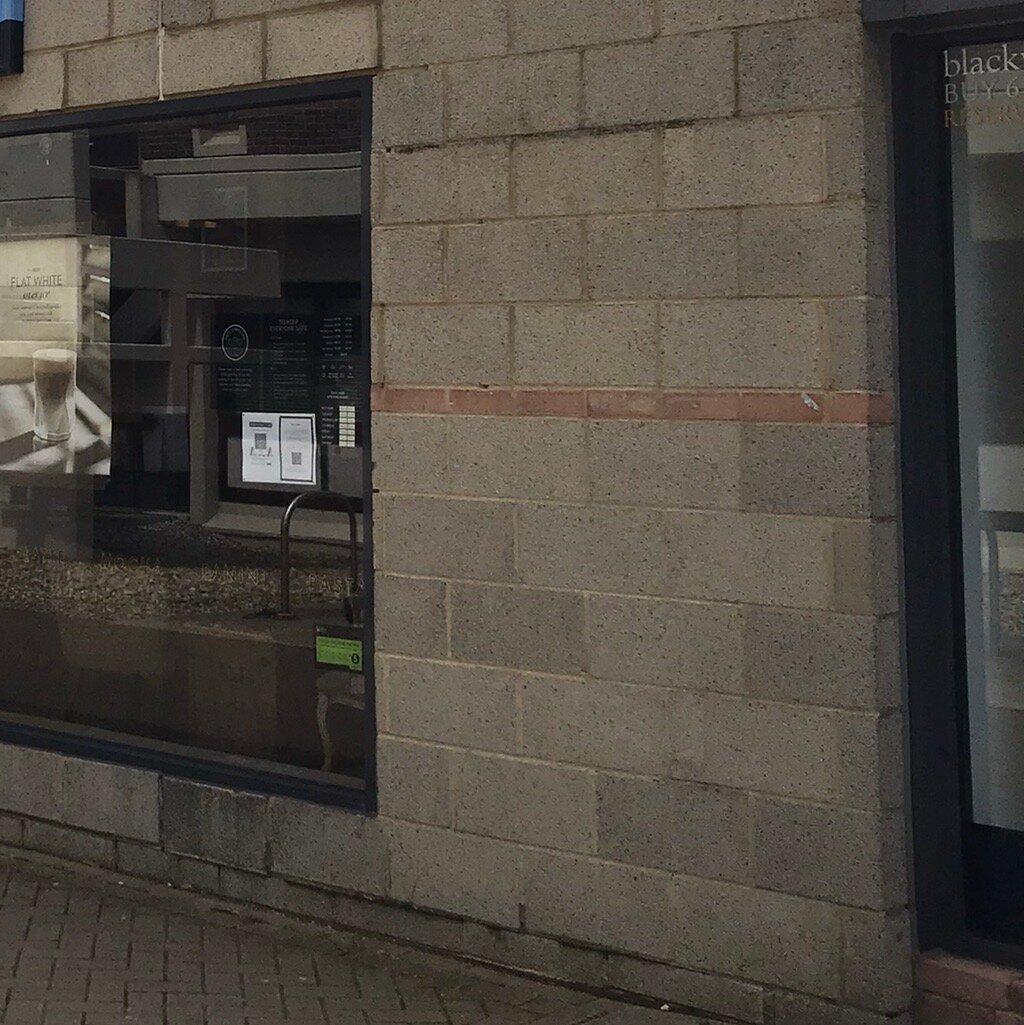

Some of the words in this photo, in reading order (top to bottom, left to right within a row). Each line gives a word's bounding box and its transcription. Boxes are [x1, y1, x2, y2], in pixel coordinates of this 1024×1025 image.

[944, 80, 997, 105] BUY
[1006, 77, 1020, 98] 6
[10, 275, 31, 288] FLAT
[33, 274, 63, 287] WHITE
